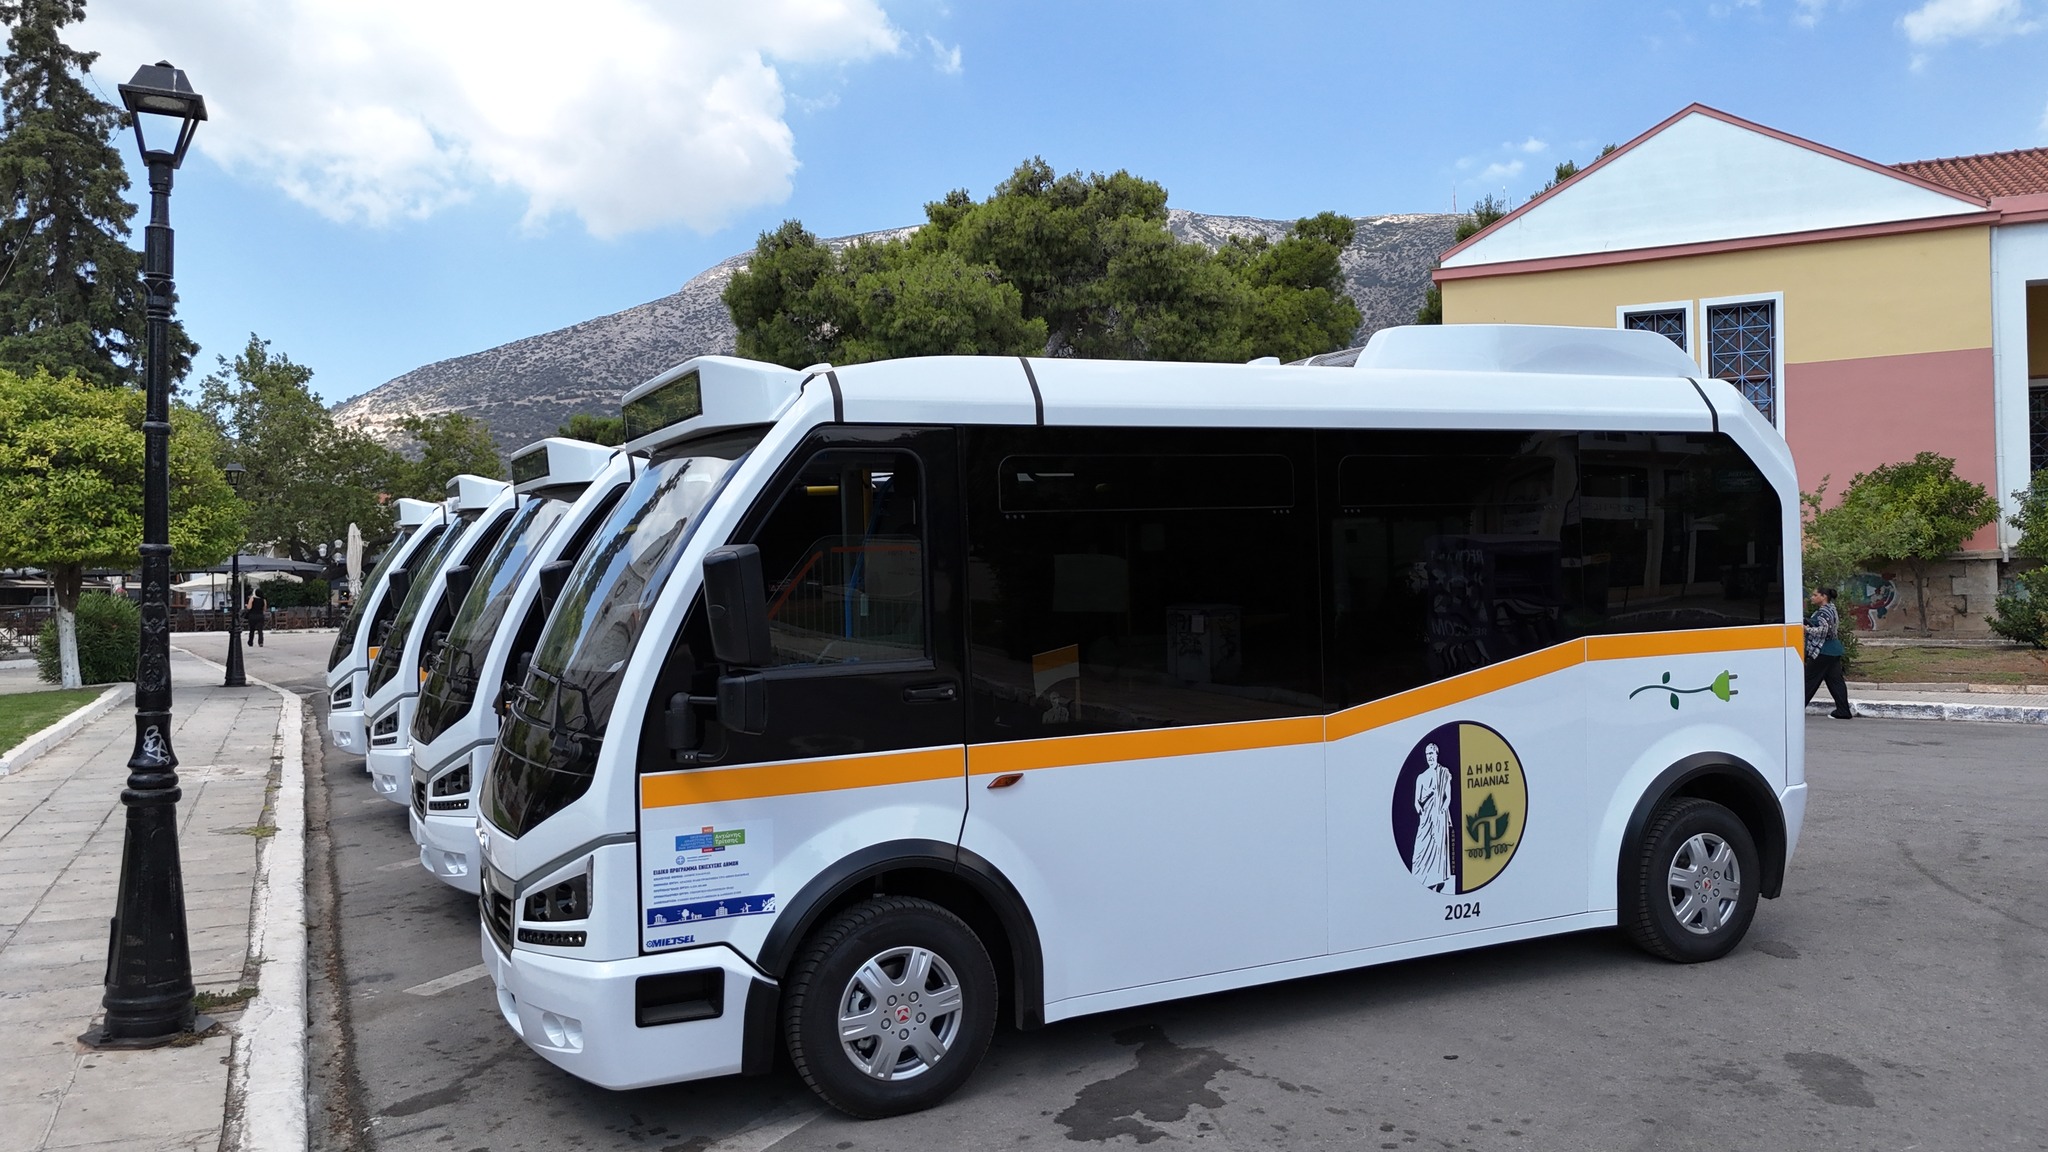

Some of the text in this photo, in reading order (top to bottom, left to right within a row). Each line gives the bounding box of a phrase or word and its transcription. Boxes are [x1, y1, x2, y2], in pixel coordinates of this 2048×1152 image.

[1467, 761, 1510, 776] ΔΗΜΟΣ
[1467, 774, 1510, 789] ΠΑΙΑΝΙΑΣ
[715, 832, 741, 840] Αντώνης
[670, 865, 698, 874] ΠΡΟΓΡΑΜΜΑ
[1445, 902, 1481, 920] 2024
[652, 935, 695, 947] MIETSEL
